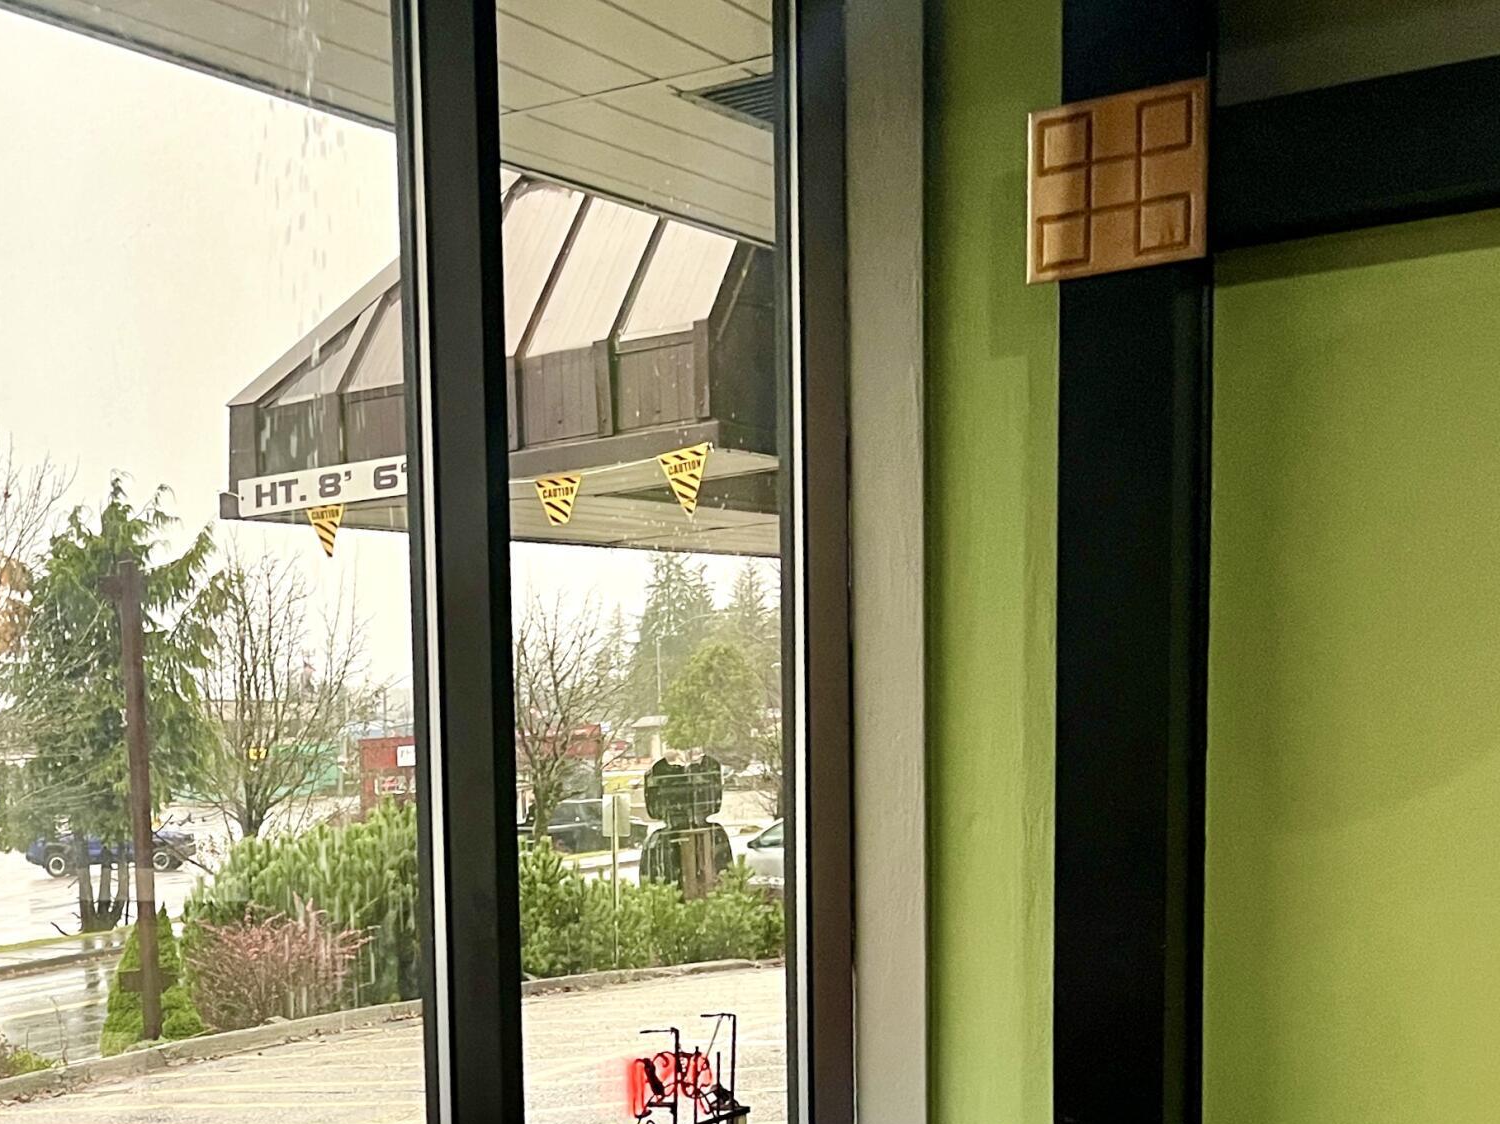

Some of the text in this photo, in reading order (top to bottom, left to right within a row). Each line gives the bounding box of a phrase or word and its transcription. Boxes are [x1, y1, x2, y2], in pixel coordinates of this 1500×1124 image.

[667, 459, 702, 475] CAUTION
[255, 478, 307, 508] HT.
[318, 470, 352, 498] 8'
[542, 485, 575, 499] CAUTION
[311, 508, 340, 521] CAUTION
